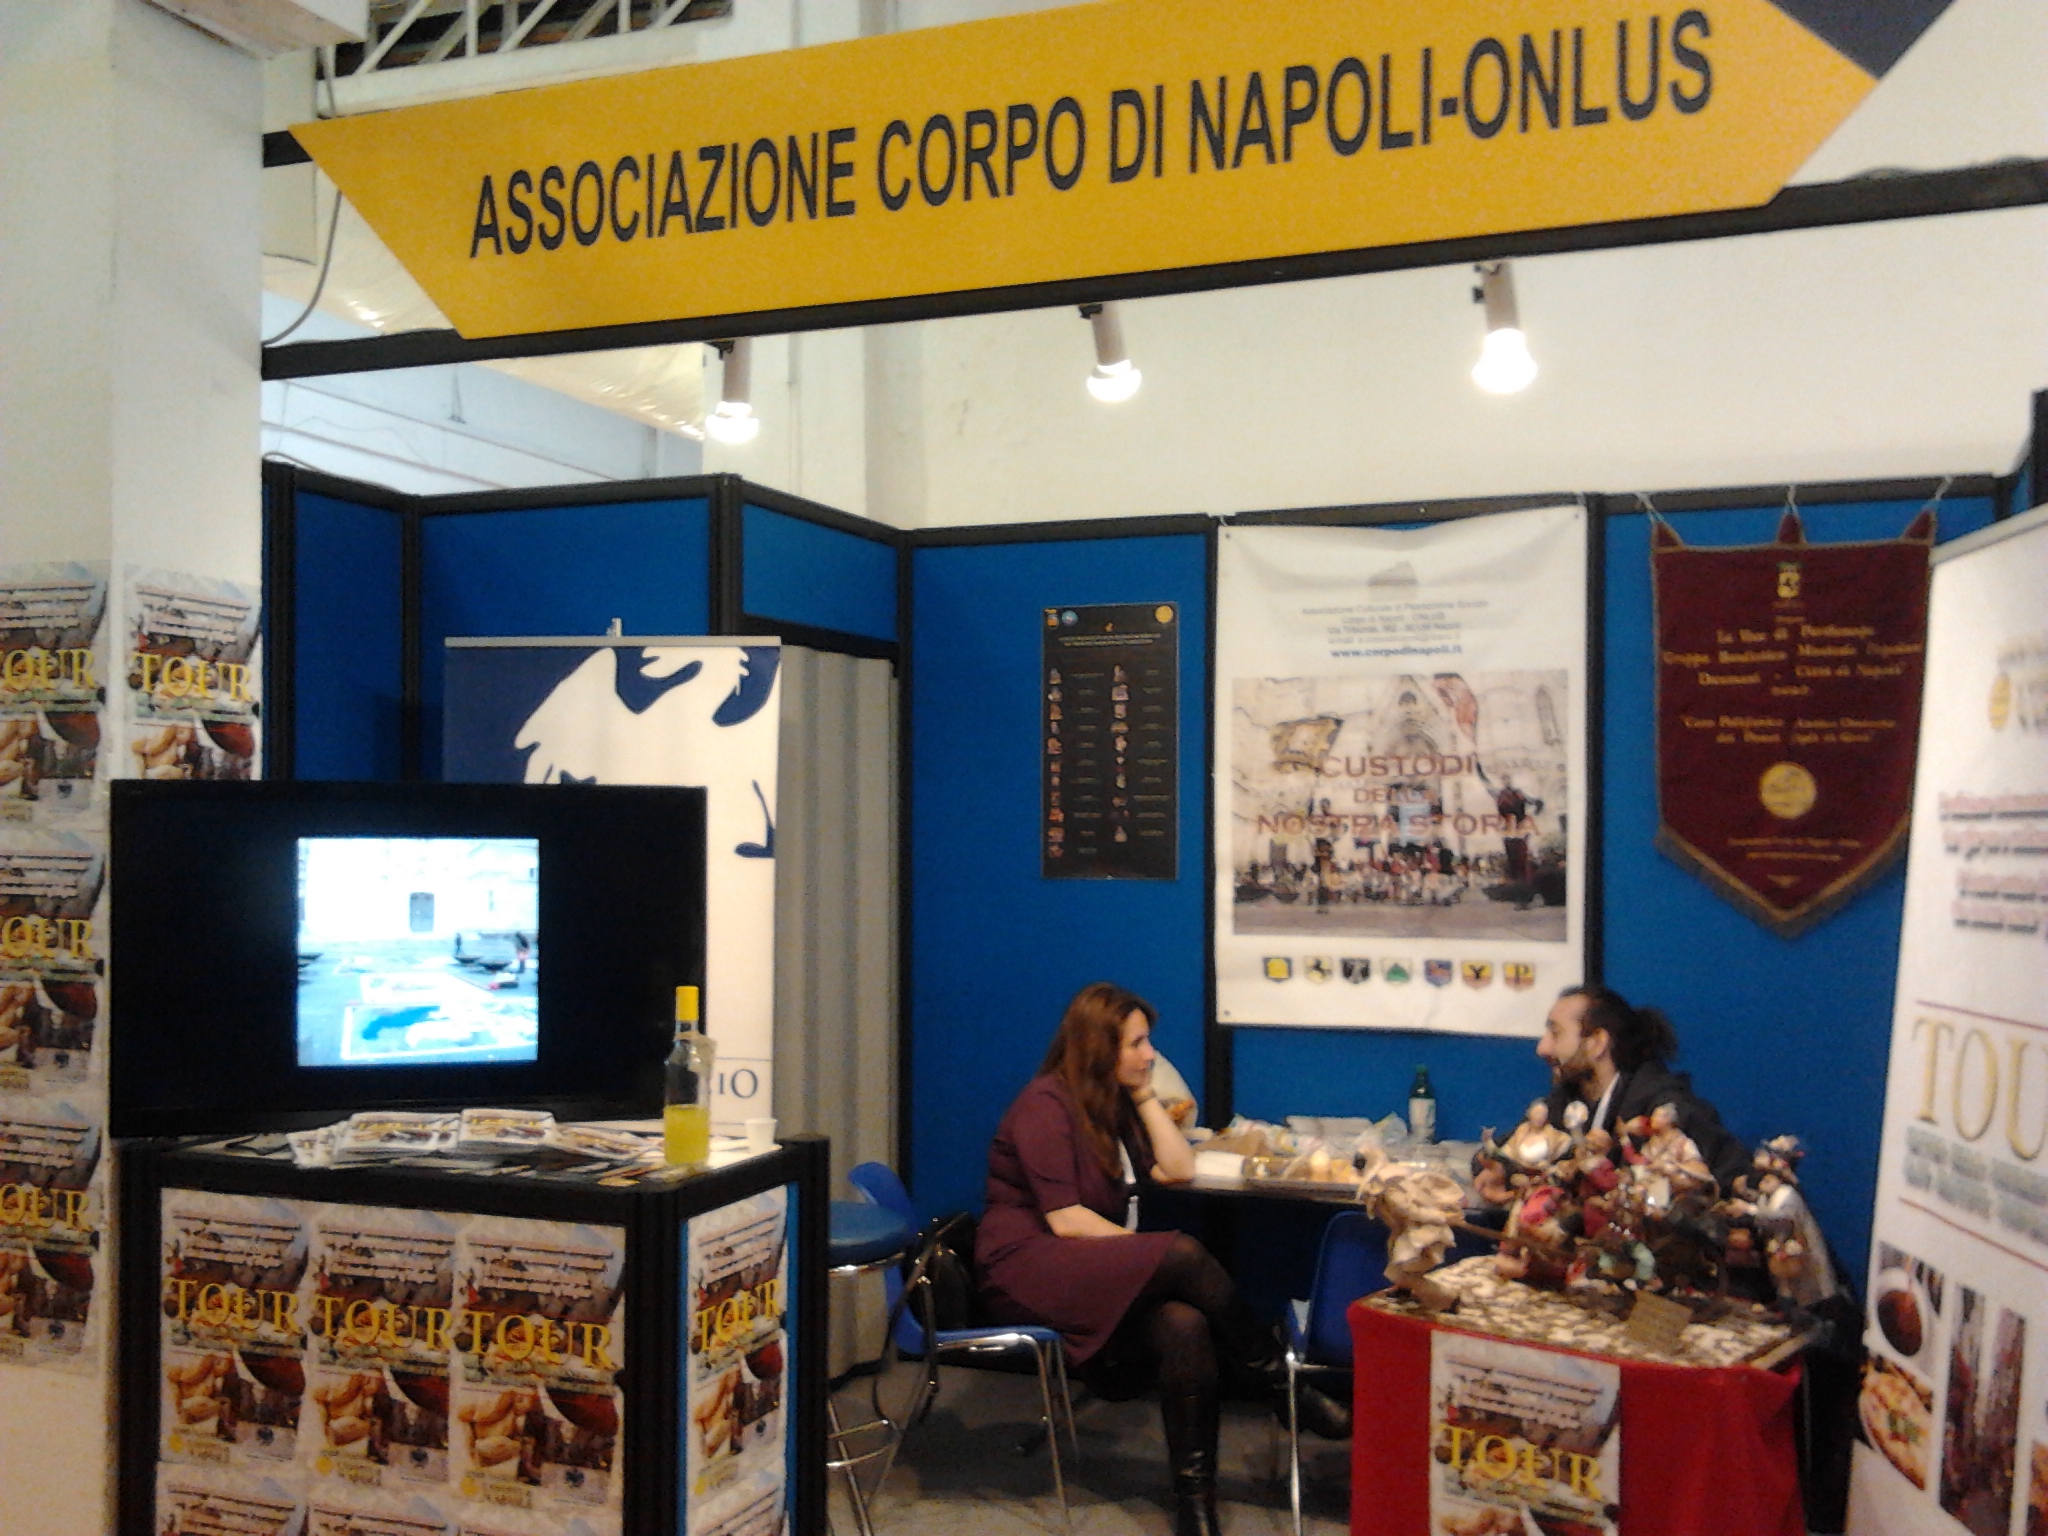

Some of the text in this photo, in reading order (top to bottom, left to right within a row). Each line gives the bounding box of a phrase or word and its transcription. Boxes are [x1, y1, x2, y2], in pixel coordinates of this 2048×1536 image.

[469, 9, 1713, 259] ASSOCIAZIONE CORPO DI NAPOLI-ONLUS
[0, 649, 98, 691] OUR
[132, 651, 251, 702] TOUR
[1319, 754, 1477, 778] CUSTODI
[0, 916, 95, 960] OUR
[0, 1183, 93, 1232] OUR
[164, 1277, 303, 1334] TOUR
[315, 1294, 455, 1352] TOUR
[693, 1278, 781, 1353] TOUR
[462, 1308, 620, 1371] TOUR
[1440, 1423, 1608, 1501] TOUR
